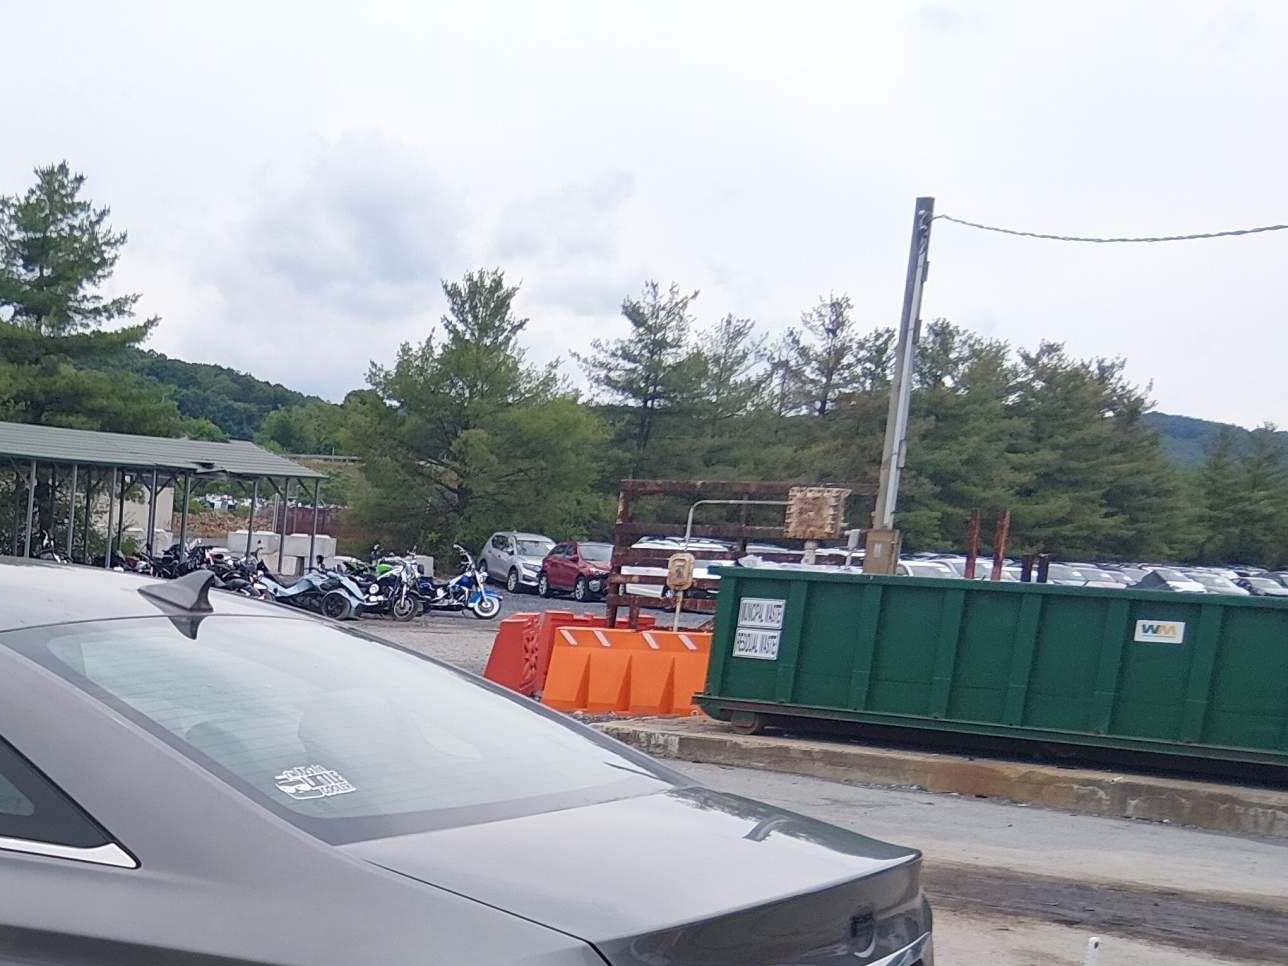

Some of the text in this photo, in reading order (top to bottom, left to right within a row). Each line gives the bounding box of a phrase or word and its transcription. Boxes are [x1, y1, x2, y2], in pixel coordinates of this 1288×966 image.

[764, 603, 783, 625] WASTE
[1142, 623, 1177, 635] WM
[759, 634, 778, 656] WASTE
